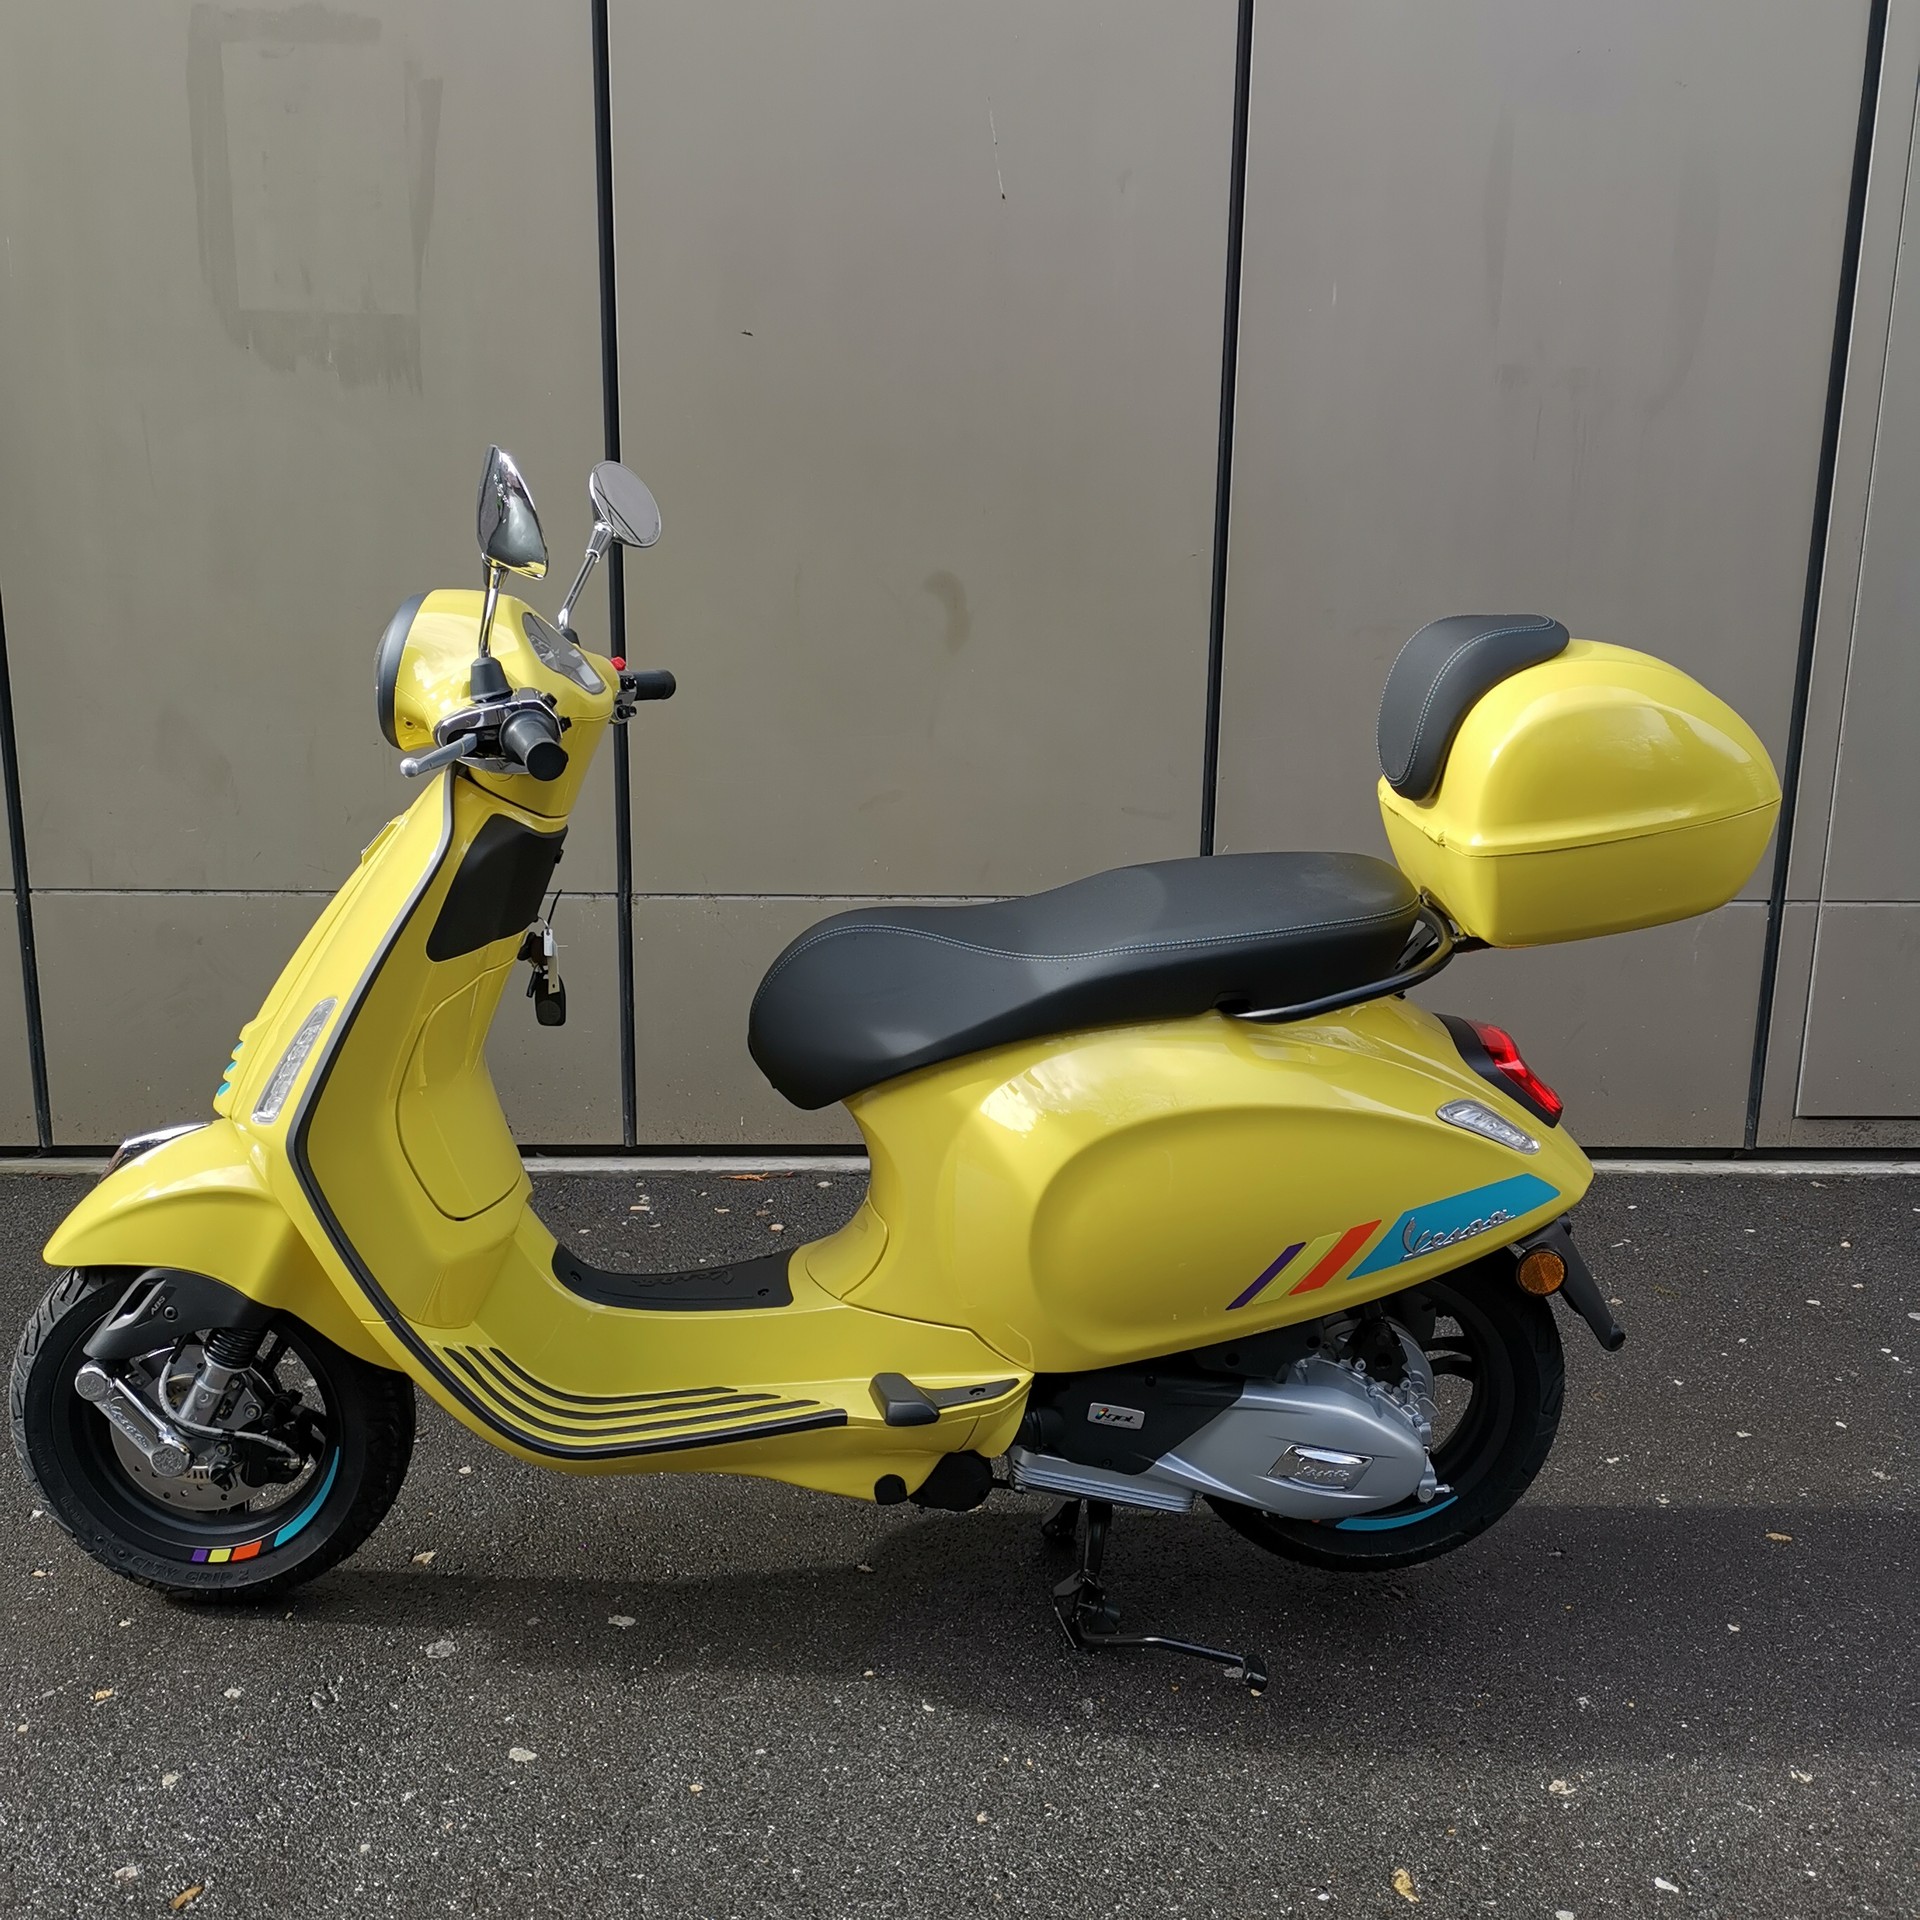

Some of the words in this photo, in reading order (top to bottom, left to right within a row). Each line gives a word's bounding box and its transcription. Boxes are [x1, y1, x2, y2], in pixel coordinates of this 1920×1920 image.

[1402, 1208, 1516, 1260] Vespa
[150, 1295, 166, 1316] ABS
[131, 1555, 179, 1579] CITY
[185, 1570, 234, 1585] GRIP
